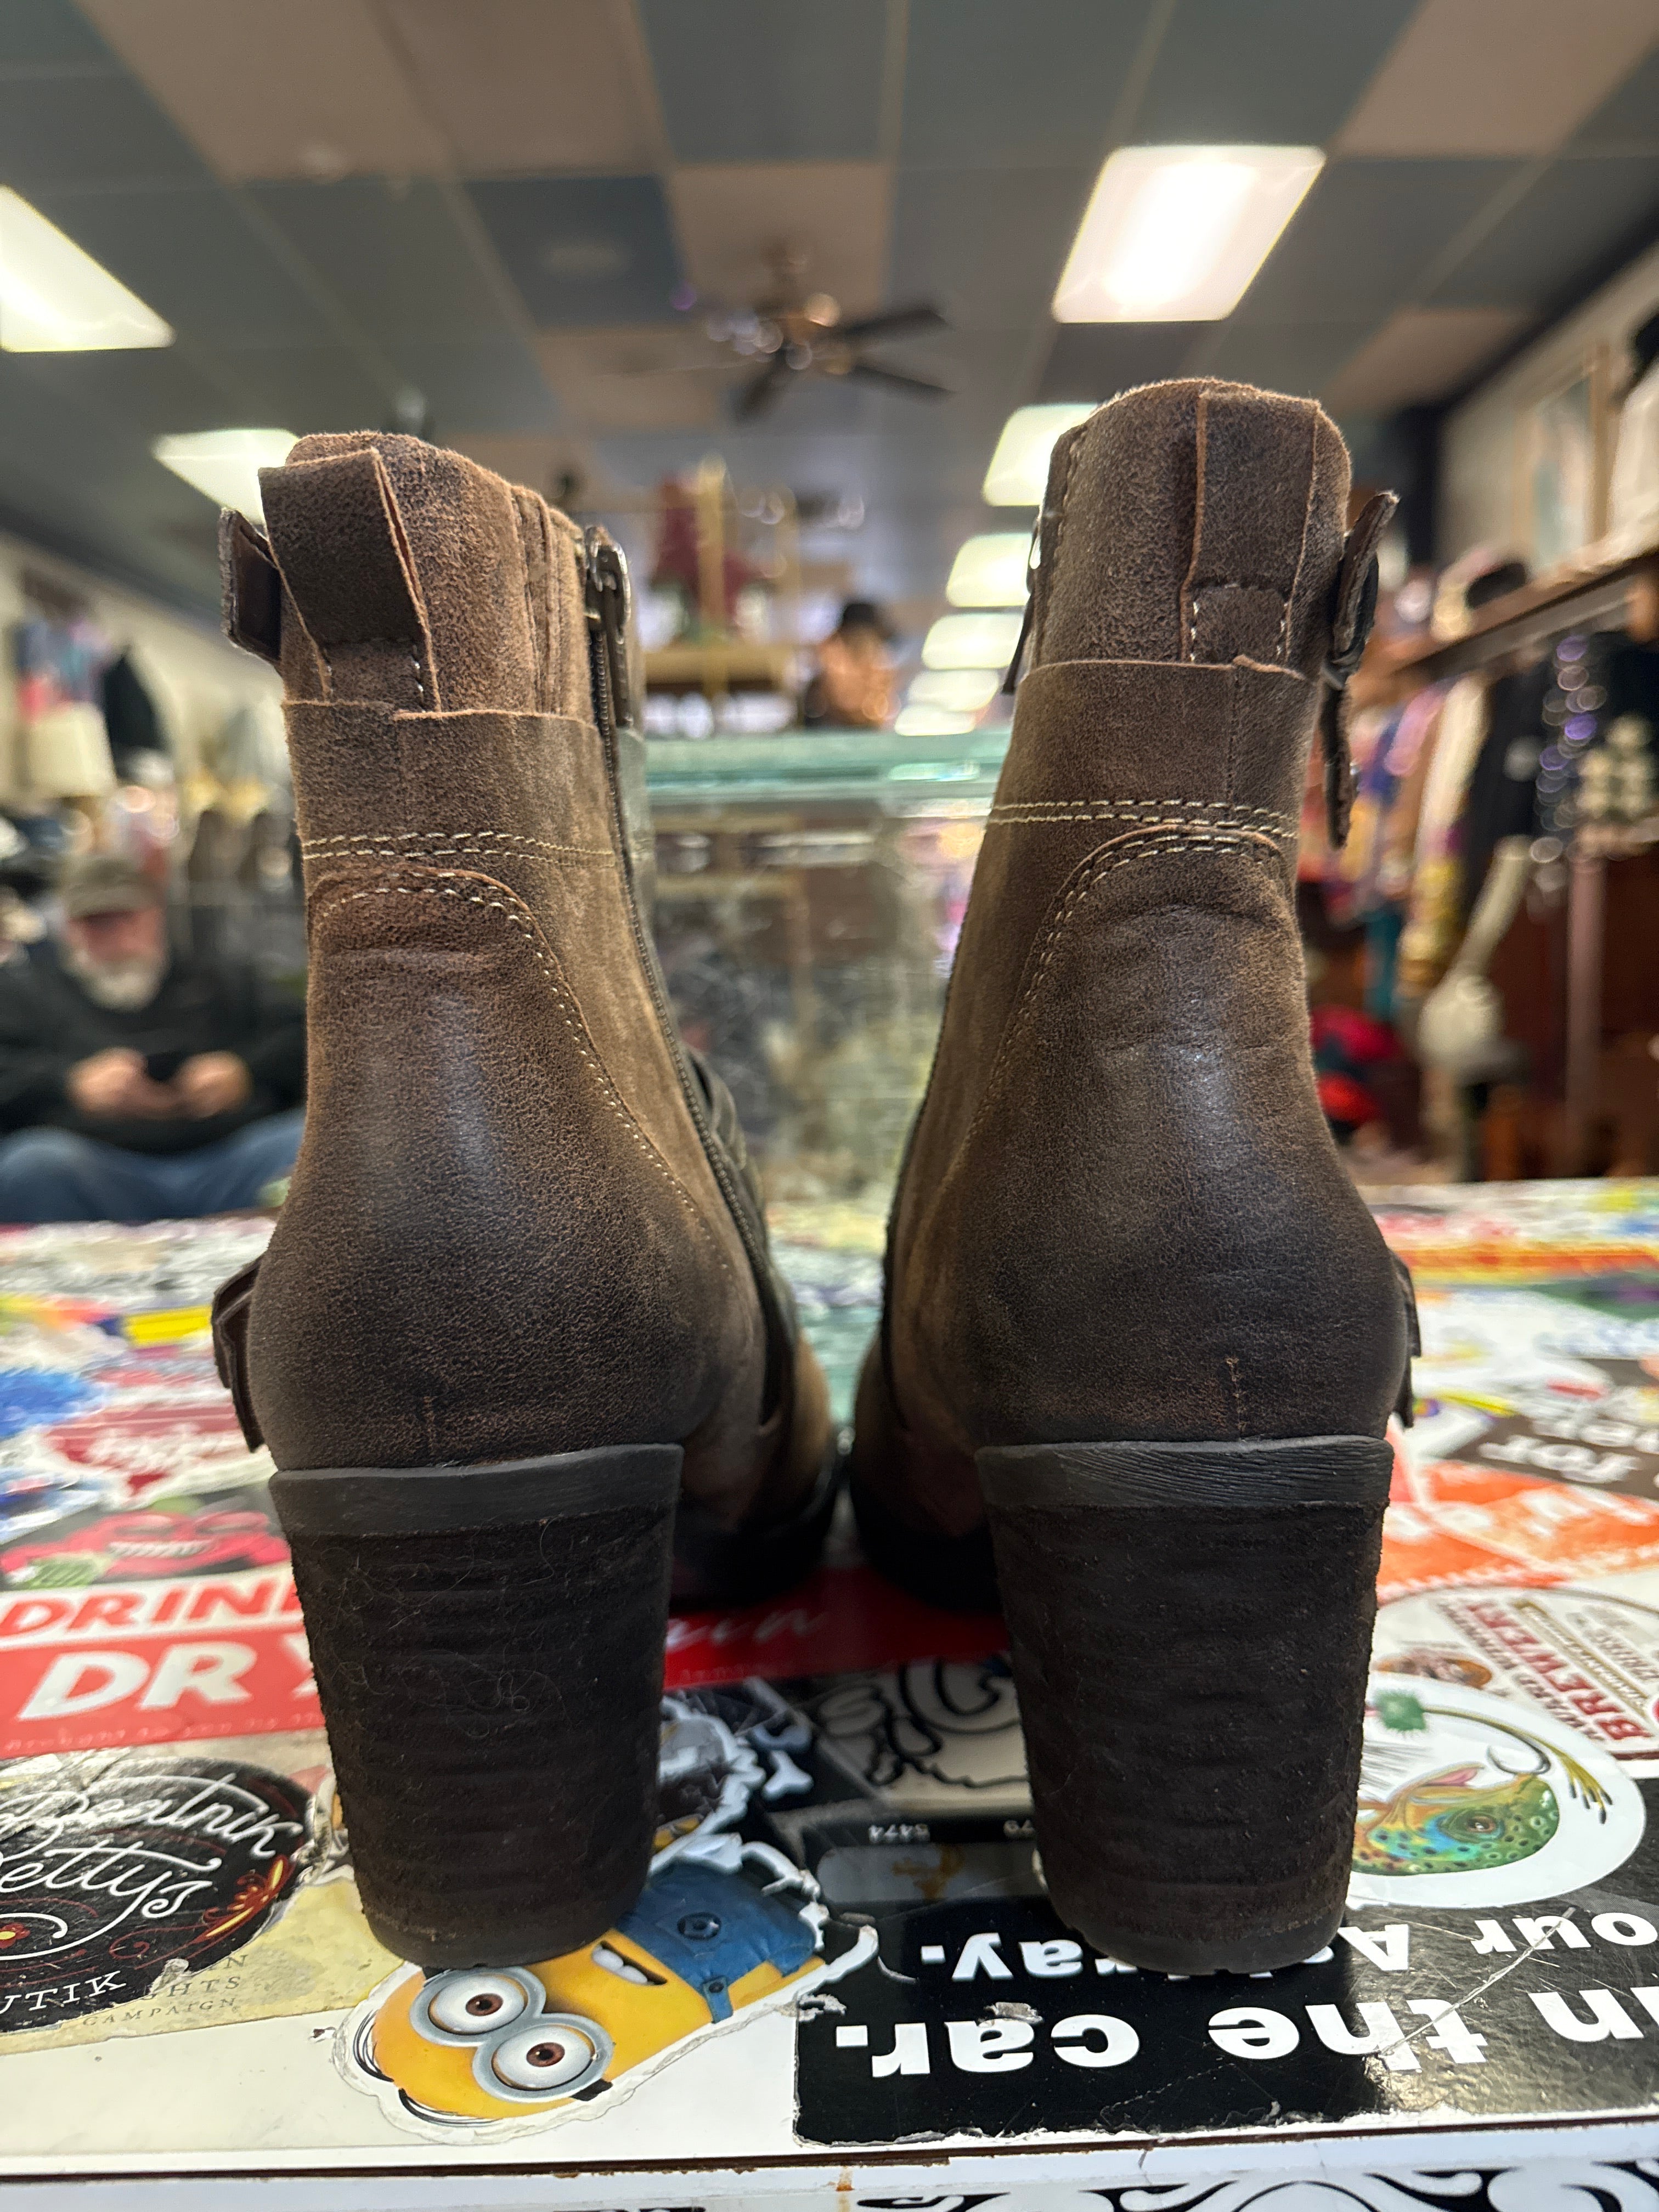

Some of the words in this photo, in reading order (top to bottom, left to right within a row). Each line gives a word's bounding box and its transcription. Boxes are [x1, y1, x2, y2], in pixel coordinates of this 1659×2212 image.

[0, 1840, 222, 1961] ettys
[836, 2014, 1140, 2078] car.
[1208, 1998, 1488, 2073] the
